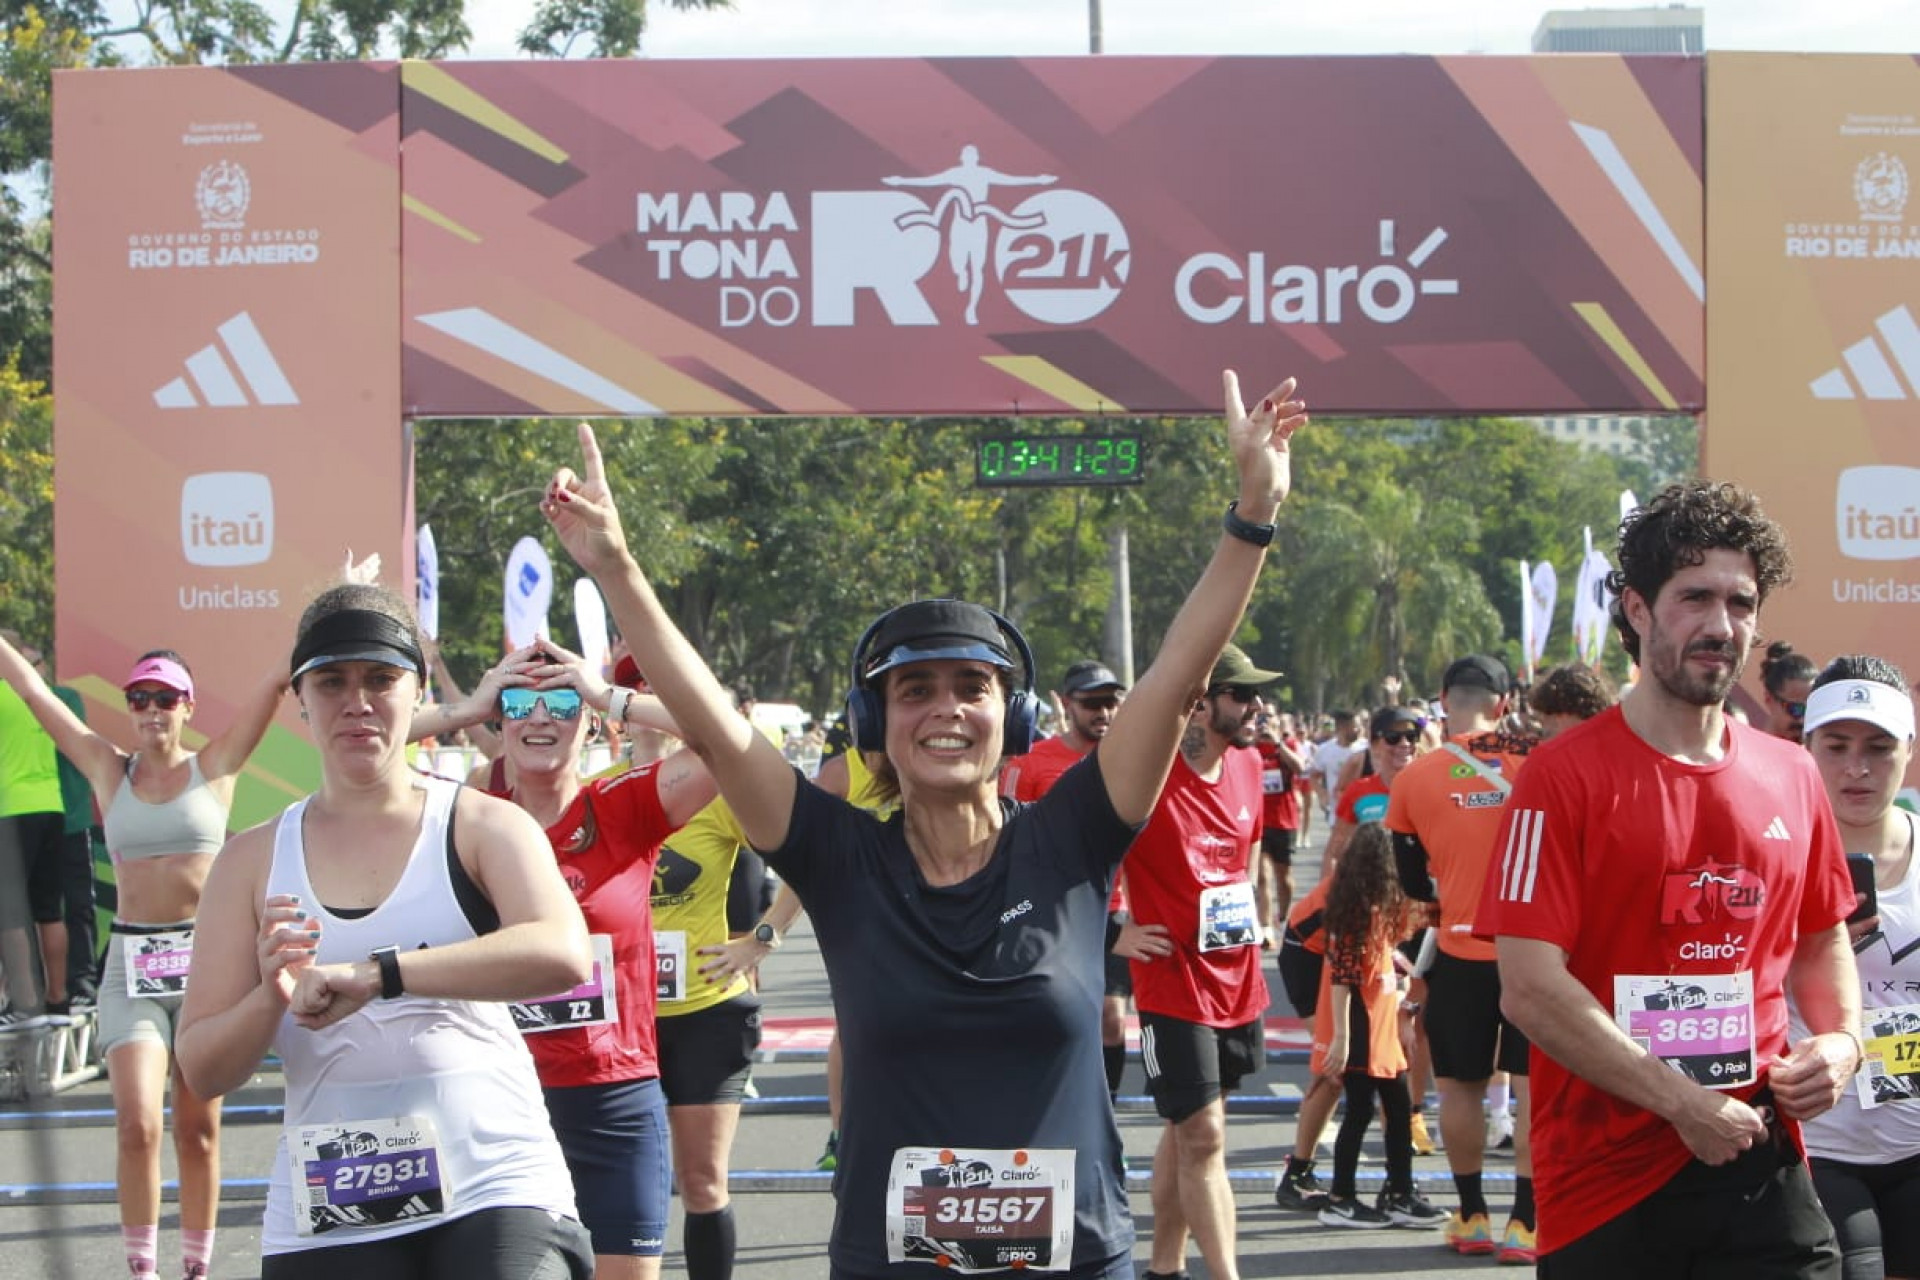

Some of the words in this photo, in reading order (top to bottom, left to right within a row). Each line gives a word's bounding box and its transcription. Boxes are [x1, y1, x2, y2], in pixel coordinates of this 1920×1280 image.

[636, 191, 799, 233] MARA
[129, 232, 212, 247] GOVERNO
[220, 231, 243, 244] DO
[251, 229, 319, 243] ESTADO
[1785, 223, 1870, 236] GOVERNO
[1878, 224, 1902, 235] DO
[129, 247, 173, 268] RIO
[177, 246, 210, 267] DE
[215, 243, 320, 266] JANEIRO
[646, 239, 799, 279] TONA
[1002, 232, 1130, 290] 21k
[1786, 238, 1831, 257] RIO
[1835, 238, 1869, 257] DE
[1174, 251, 1416, 324] Claro
[720, 286, 800, 327] DO
[981, 440, 1138, 476] 03:41:29
[190, 512, 265, 547] itaú
[178, 582, 281, 610] Uniclass
[1727, 886, 1765, 908] 21k
[1679, 942, 1736, 960] Claro
[1657, 1012, 1747, 1043] 36361
[385, 1135, 417, 1148] Claro
[334, 1156, 429, 1190] 27931
[1000, 1169, 1035, 1181] Claro
[935, 1196, 1046, 1223] 31567
[974, 1225, 1005, 1235] TAISA
[1009, 1251, 1037, 1262] RIO
